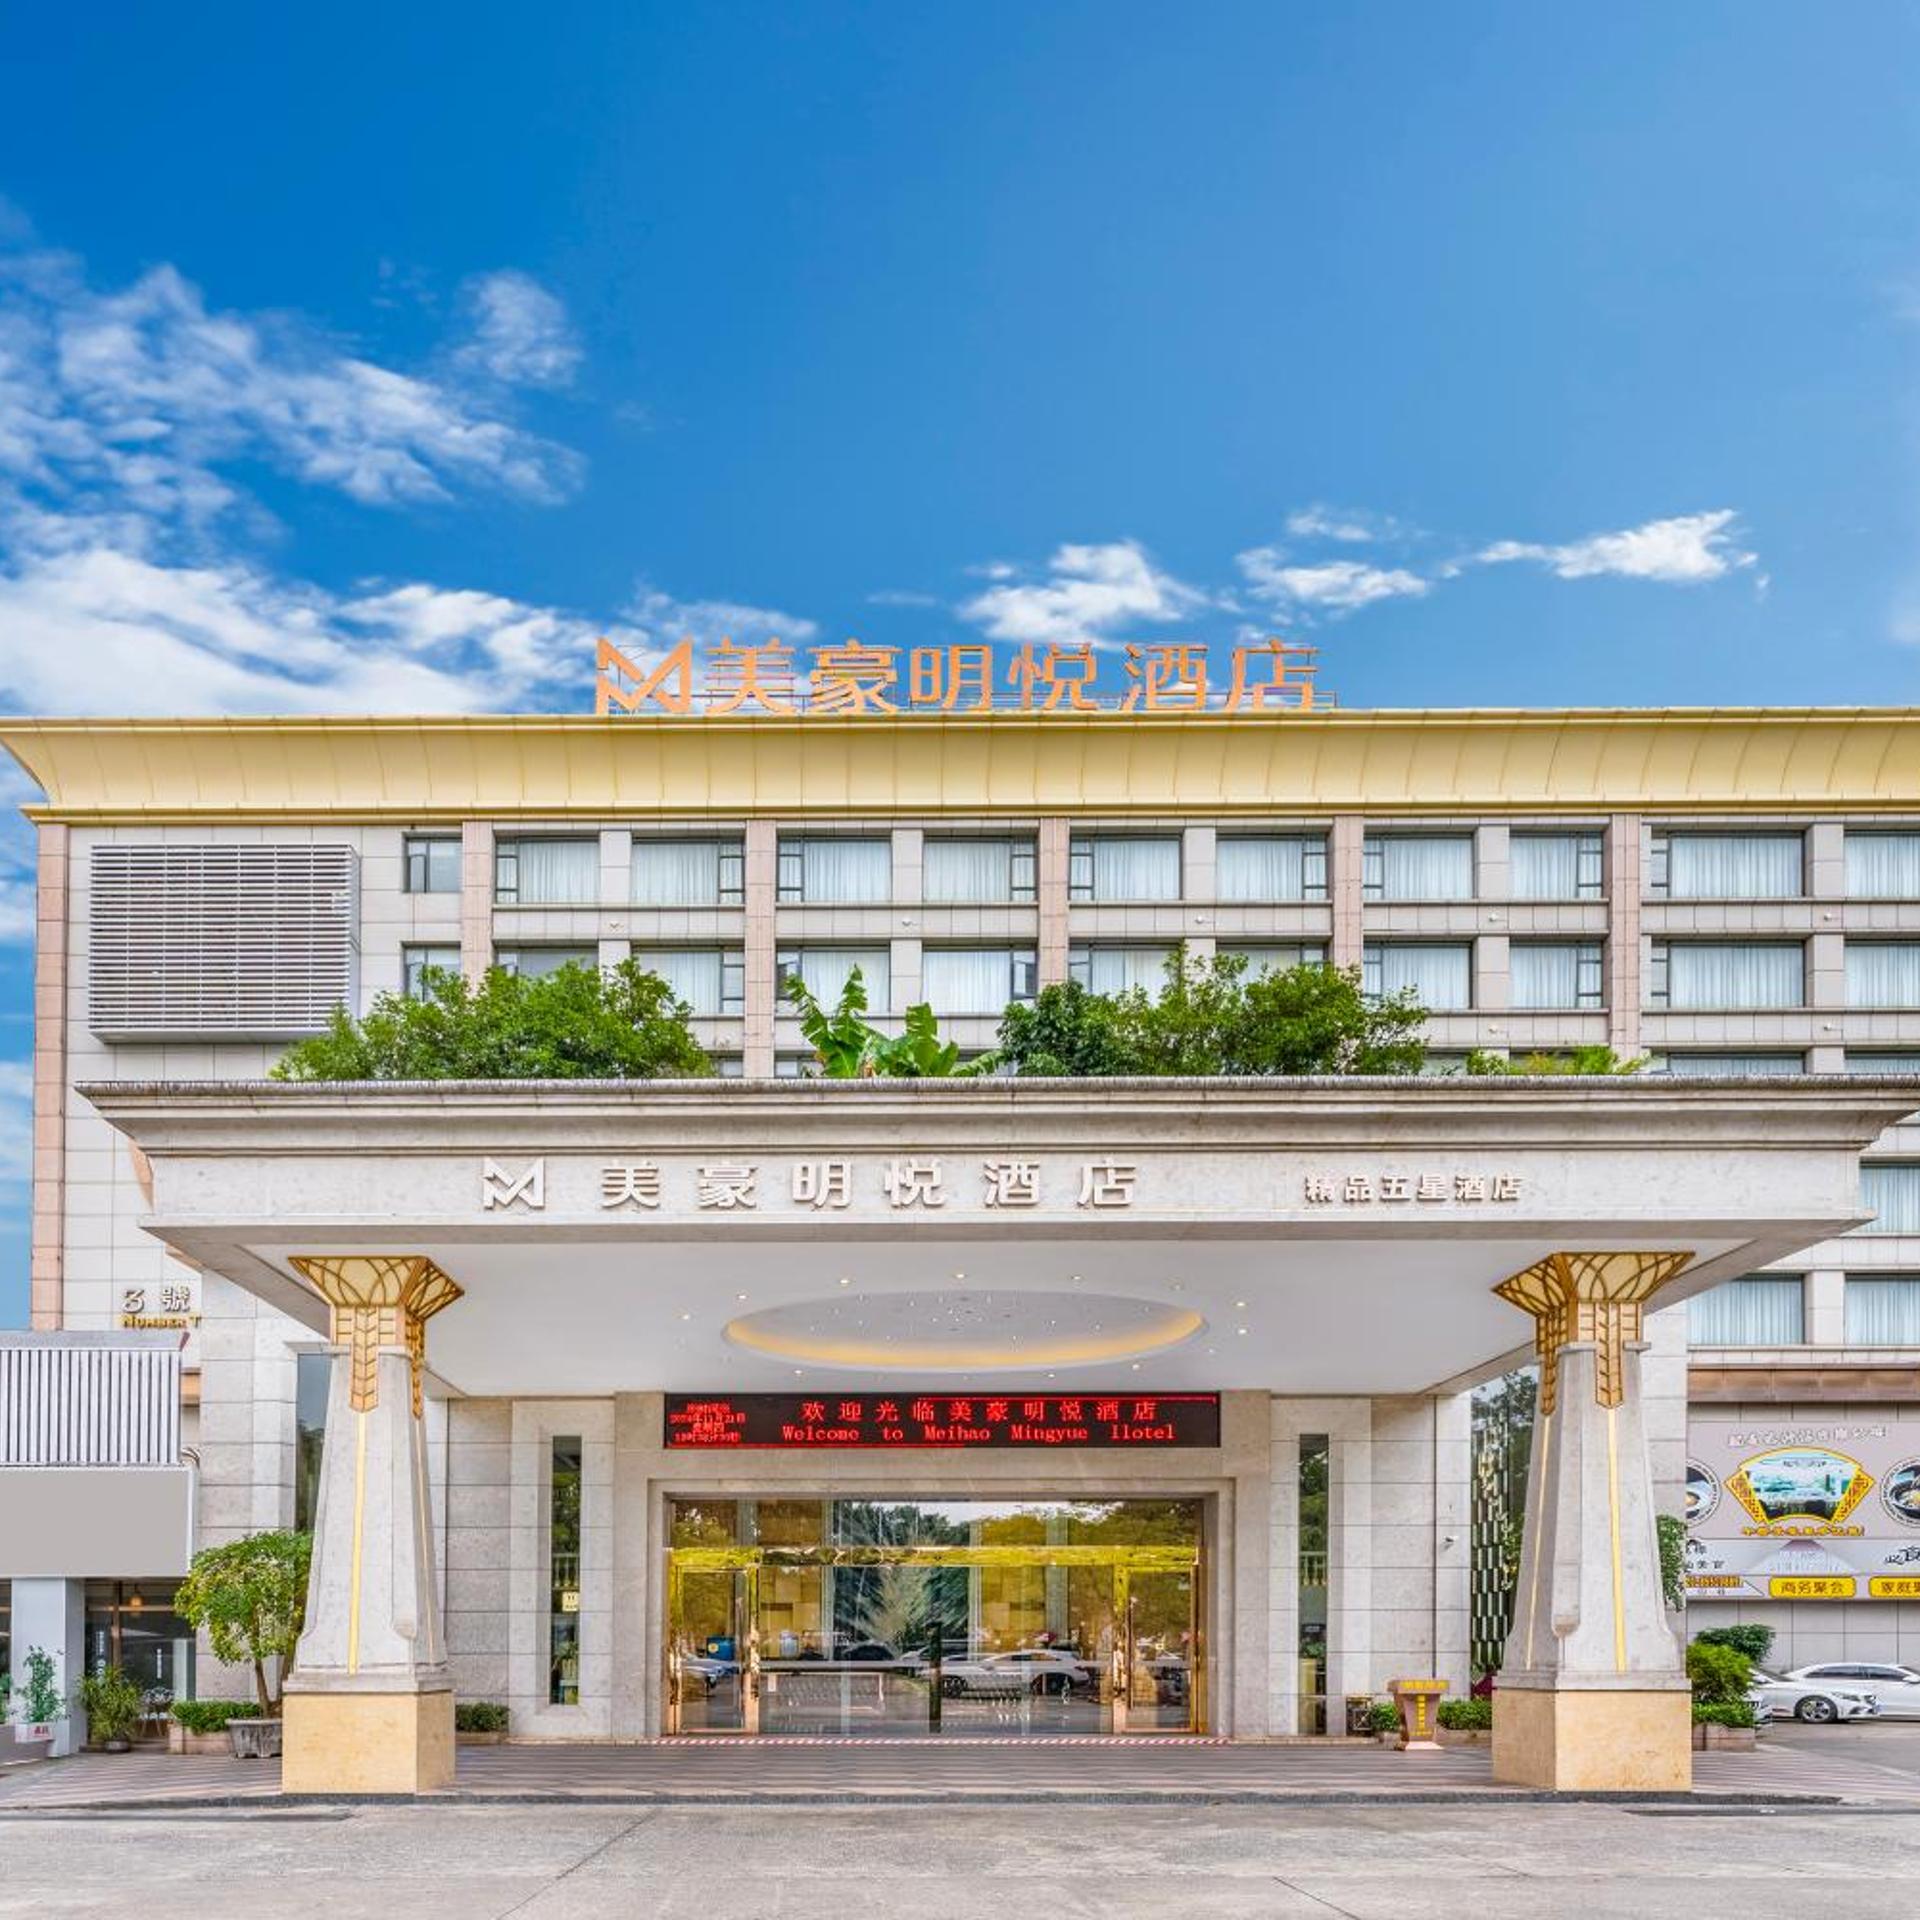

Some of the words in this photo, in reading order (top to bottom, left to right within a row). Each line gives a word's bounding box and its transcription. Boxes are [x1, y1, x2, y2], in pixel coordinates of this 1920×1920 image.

[702, 638, 1320, 714] 美豪明悦酒店
[601, 1157, 1137, 1210] 美豪明悦酒店
[1304, 1172, 1524, 1203] 精品五星酒店
[801, 1401, 1158, 1422] 欢迎光临美豪明悦酒店
[782, 1425, 860, 1441] Welcome
[883, 1426, 903, 1441] to
[925, 1425, 991, 1441] Meihao
[1011, 1424, 1089, 1443] Mingyue
